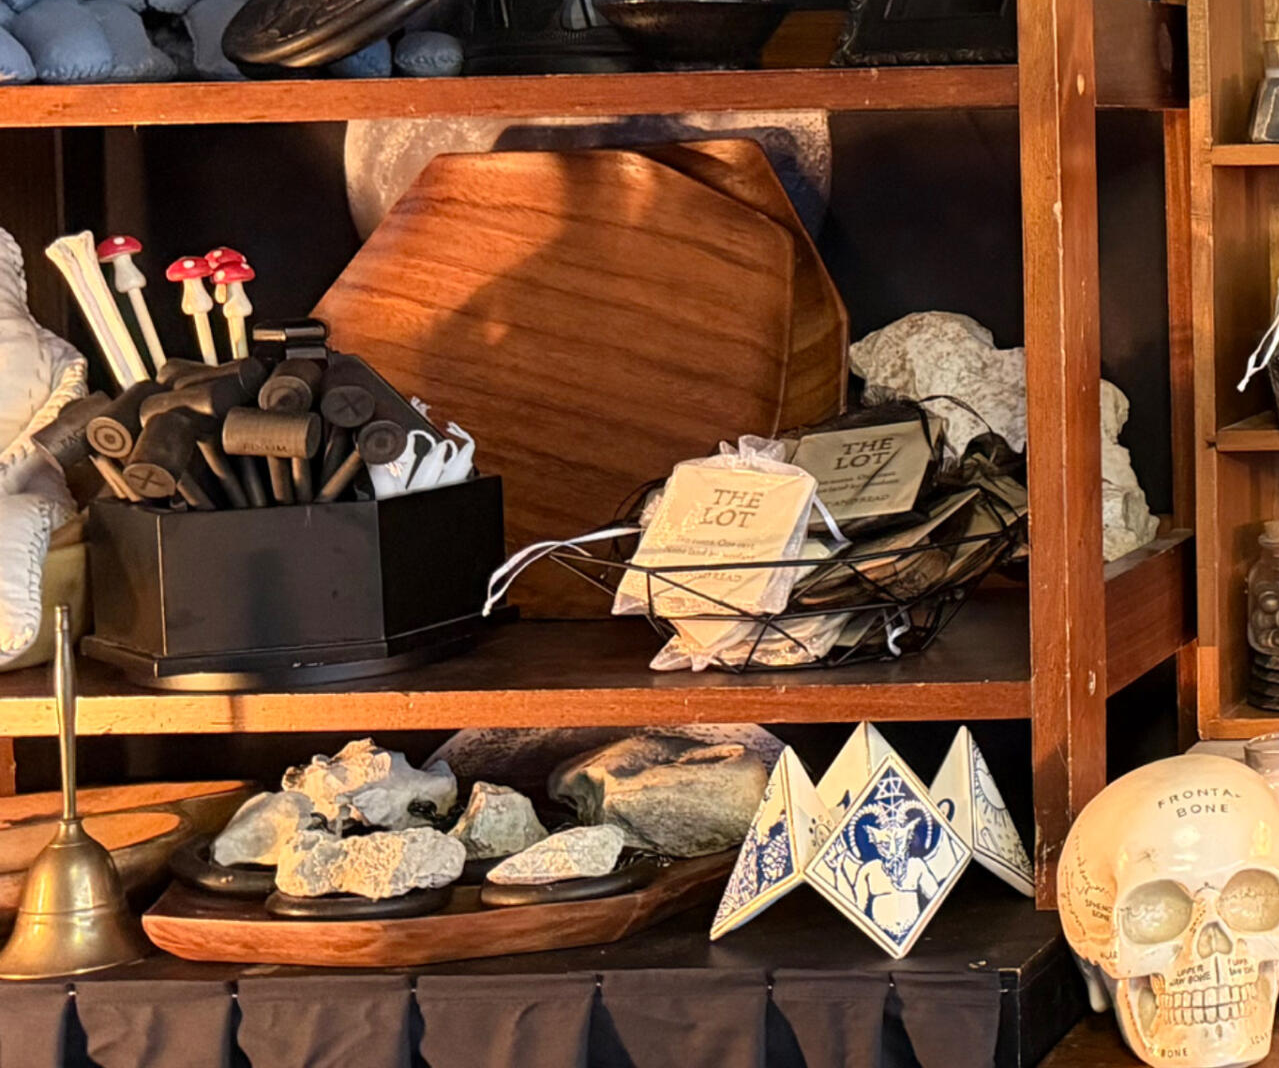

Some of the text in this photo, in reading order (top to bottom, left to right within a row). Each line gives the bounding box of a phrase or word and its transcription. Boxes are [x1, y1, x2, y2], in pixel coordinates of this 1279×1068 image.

[842, 437, 895, 455] THE
[833, 452, 890, 470] LOT
[713, 488, 764, 509] THE
[699, 506, 756, 528] LOT
[1176, 804, 1228, 818] BONE
